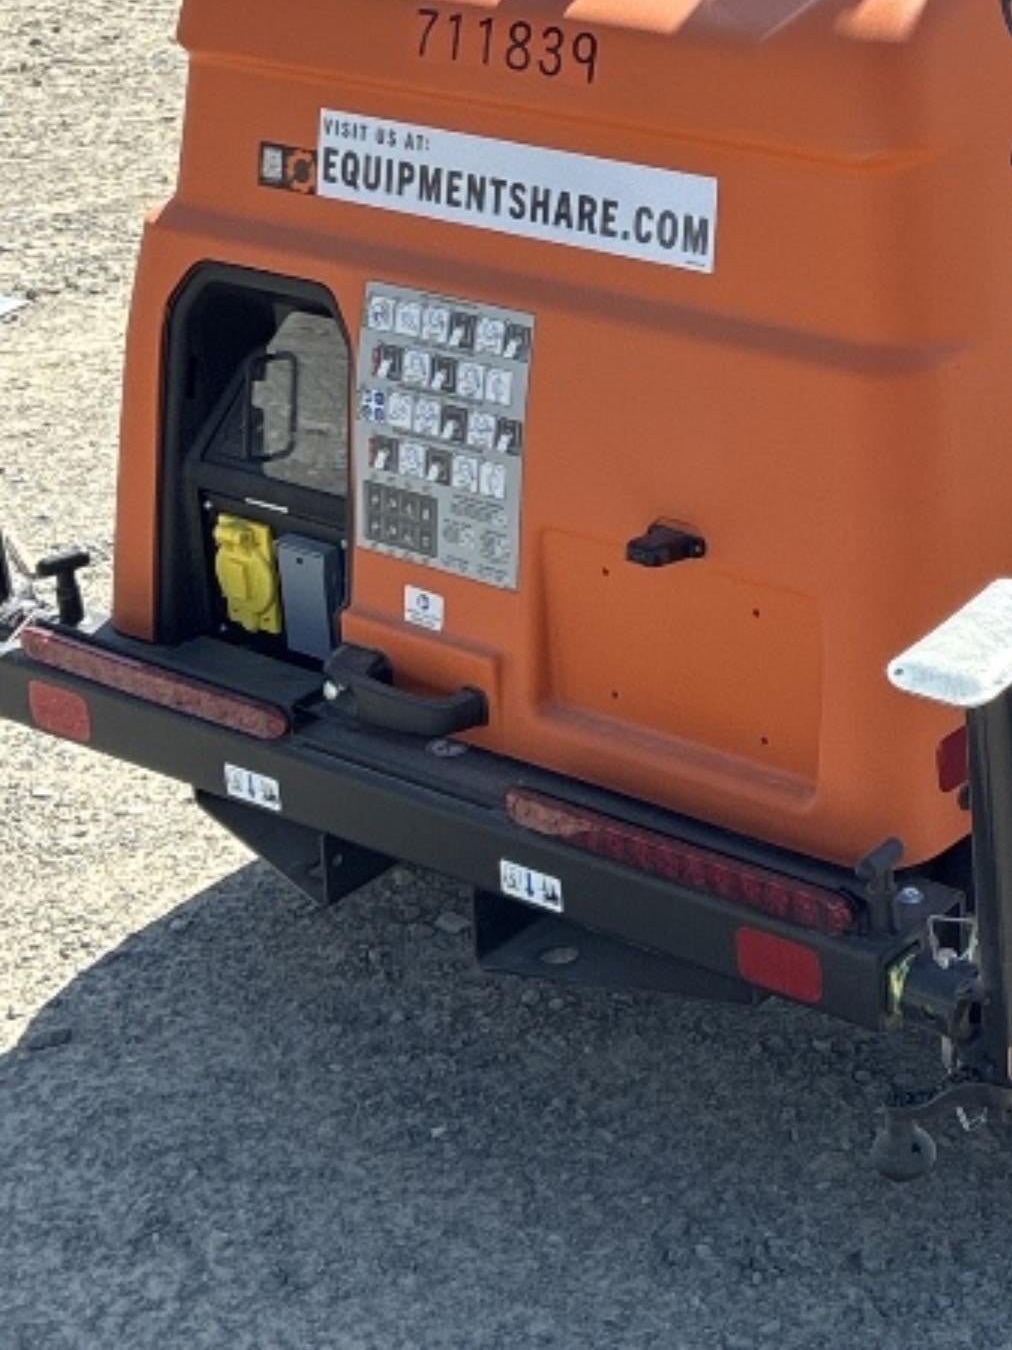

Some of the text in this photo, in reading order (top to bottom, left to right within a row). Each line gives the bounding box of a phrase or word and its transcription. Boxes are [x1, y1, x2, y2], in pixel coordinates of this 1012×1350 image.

[417, 7, 598, 84] 711839
[323, 117, 431, 151] VISIT US AT:
[322, 146, 709, 256] EQUIPMENTSHARE.COM
